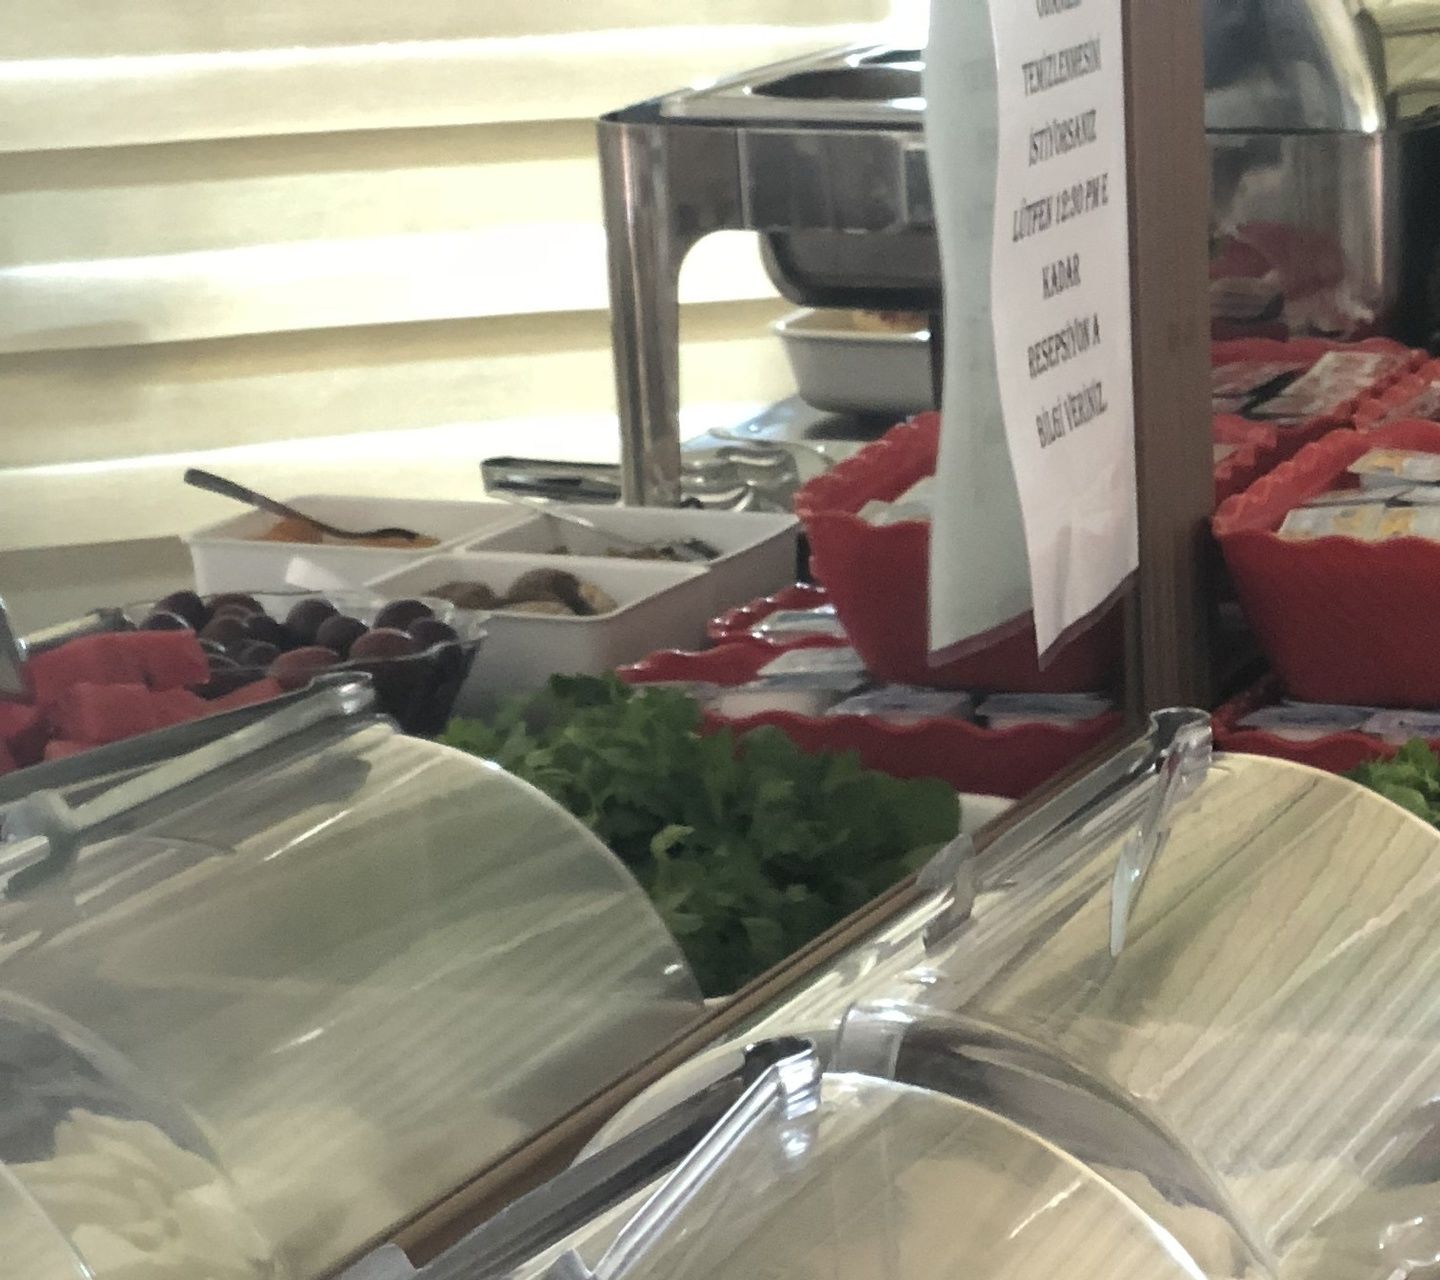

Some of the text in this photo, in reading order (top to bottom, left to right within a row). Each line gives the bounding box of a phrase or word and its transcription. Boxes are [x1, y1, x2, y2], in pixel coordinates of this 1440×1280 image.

[1042, 252, 1081, 299] KADAR
[1092, 312, 1101, 345] A
[1036, 397, 1066, 448] BİLGİ
